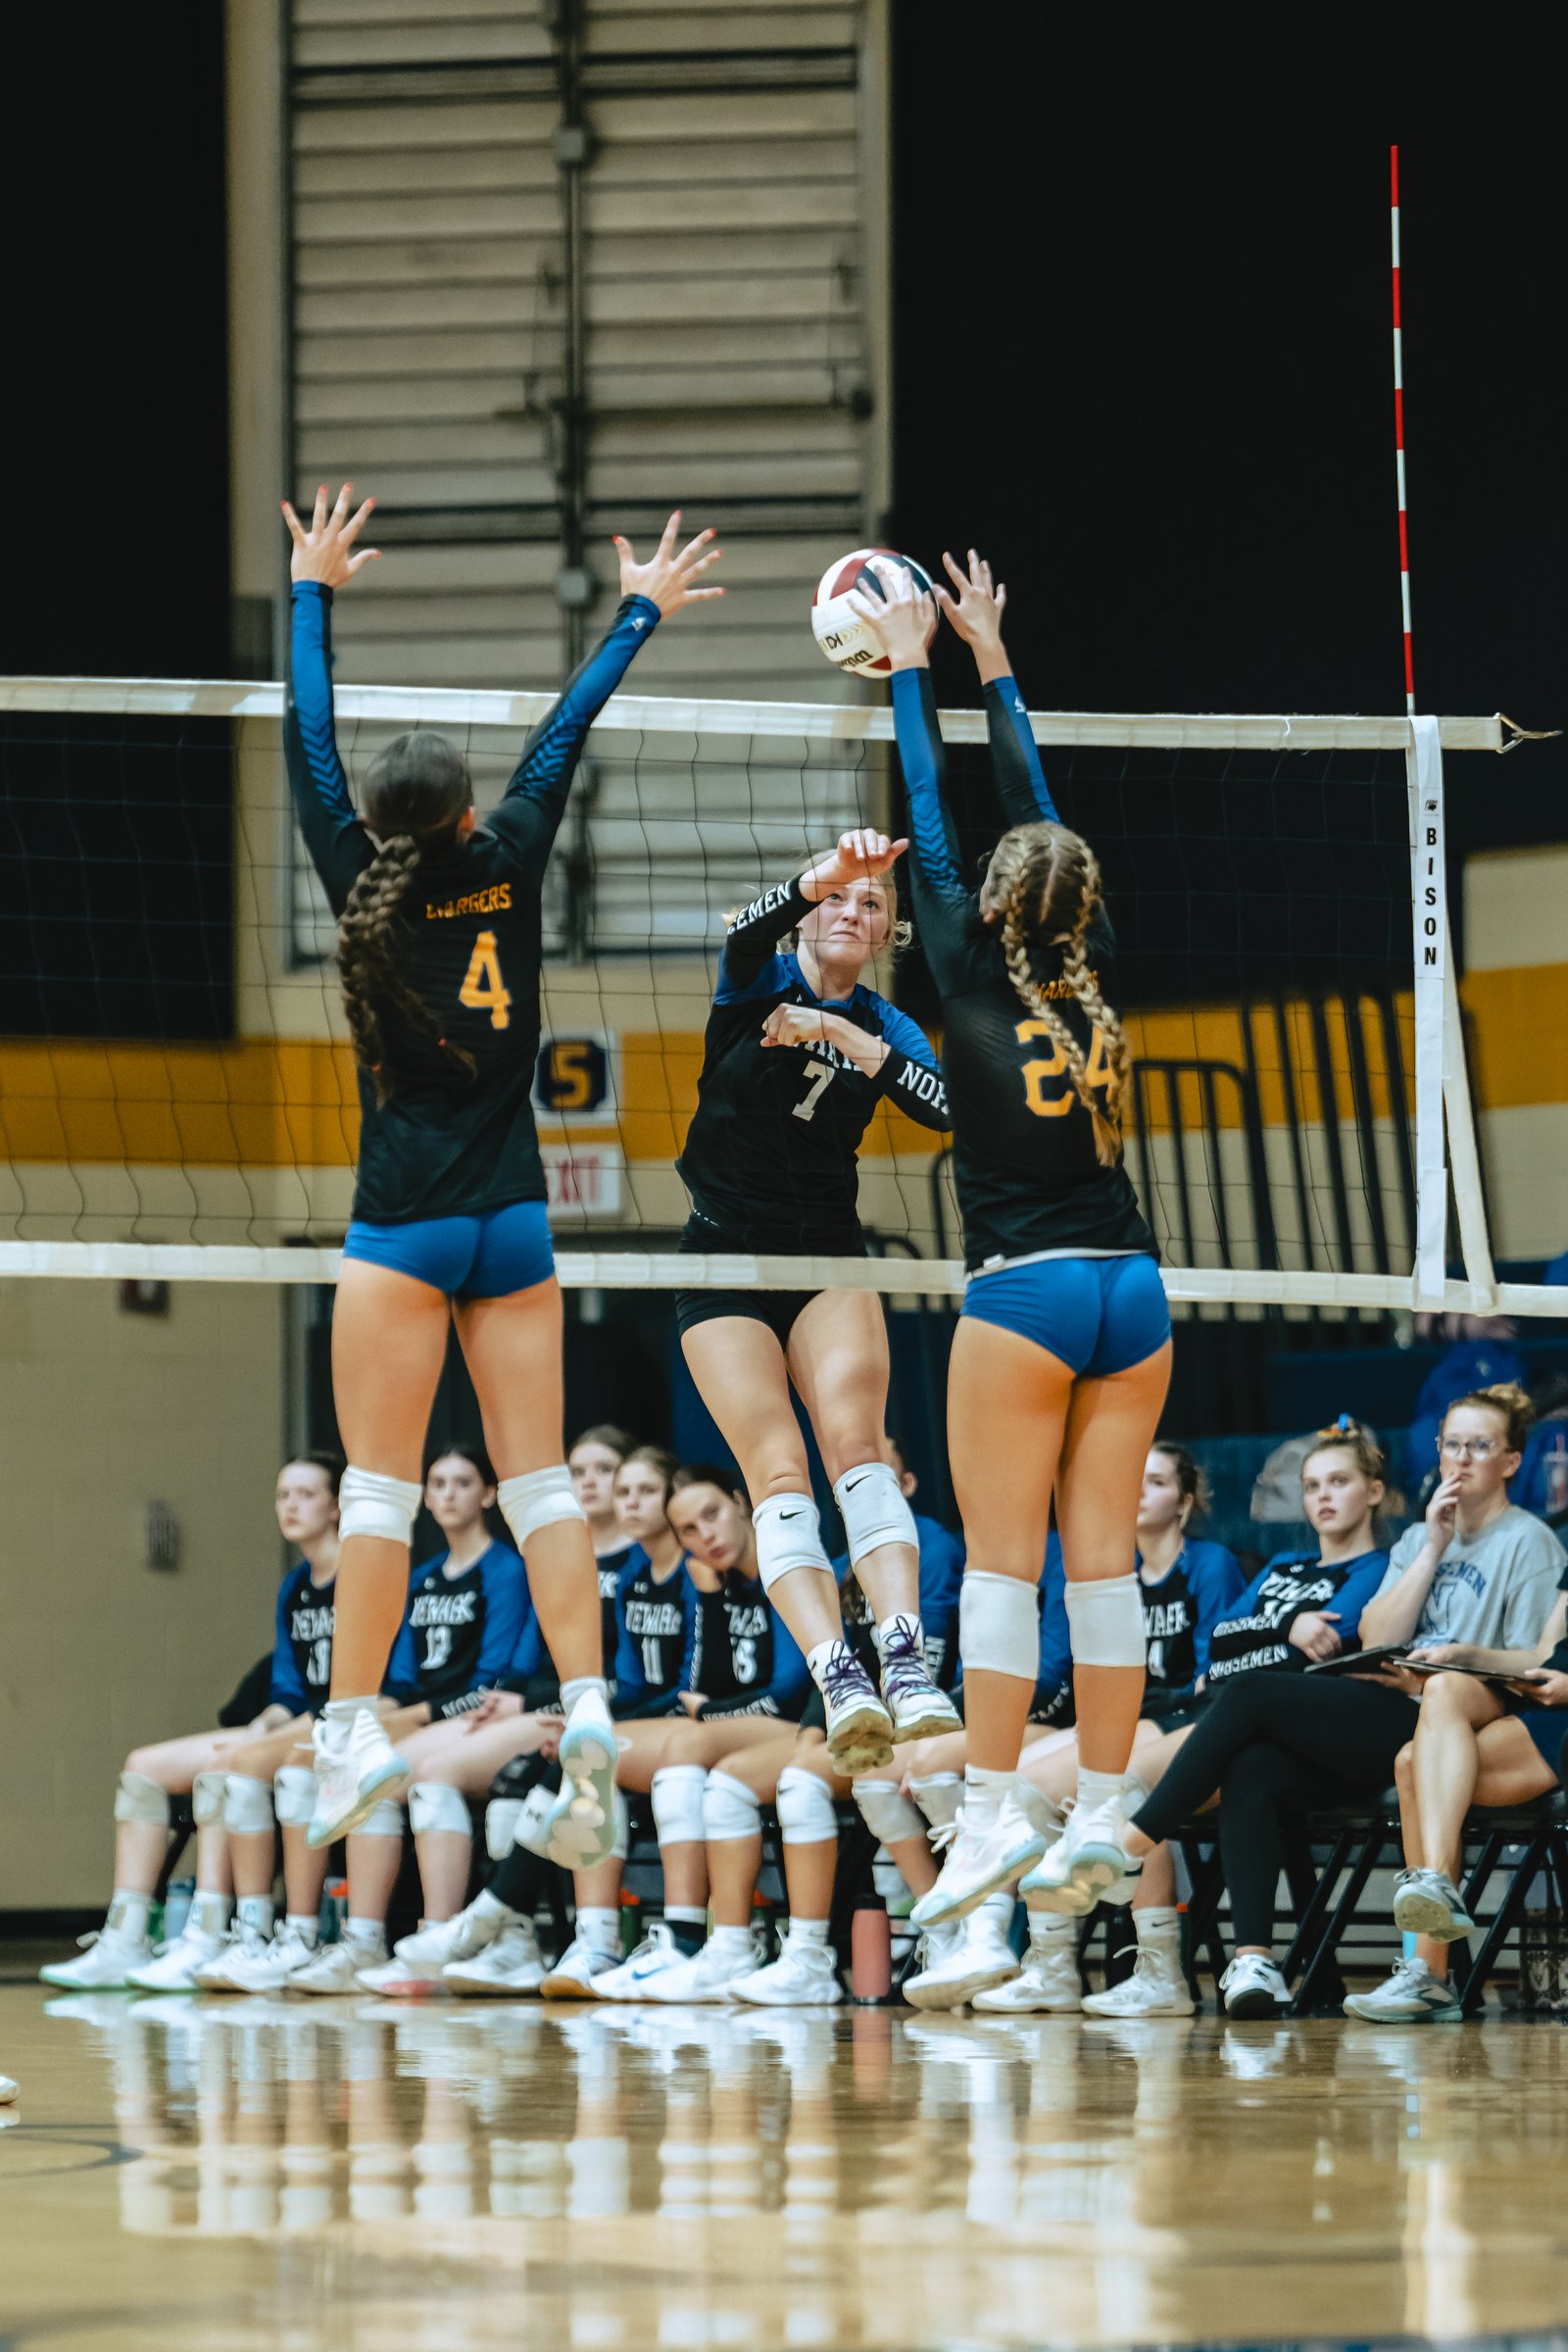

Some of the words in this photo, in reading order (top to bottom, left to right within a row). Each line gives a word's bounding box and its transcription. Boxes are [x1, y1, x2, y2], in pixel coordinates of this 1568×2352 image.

[1424, 827, 1437, 965] BISON
[459, 930, 512, 1030] 4
[792, 1059, 836, 1121] 7
[1015, 1019, 1117, 1117] 24
[546, 1155, 600, 1203] XIT
